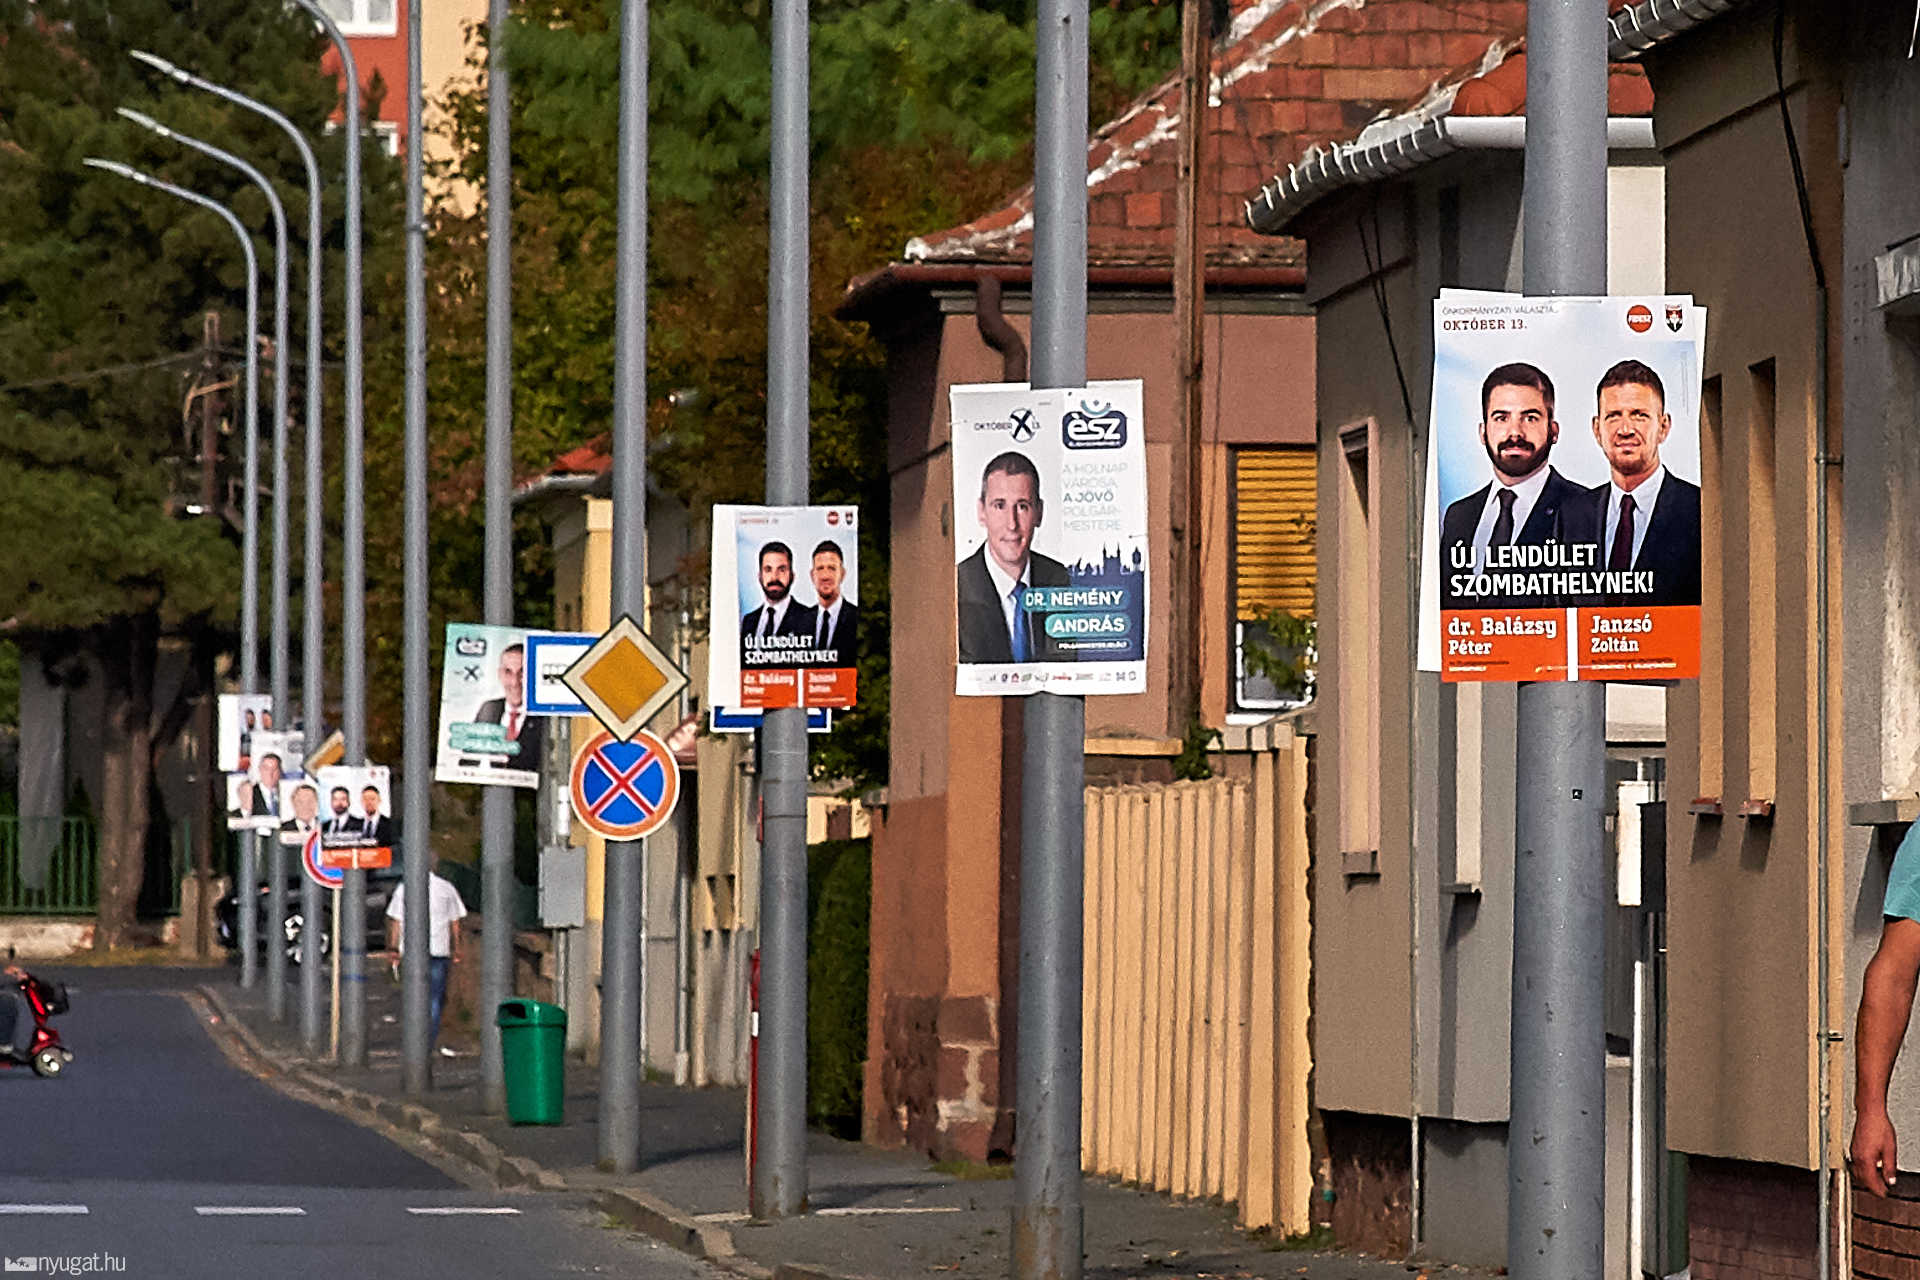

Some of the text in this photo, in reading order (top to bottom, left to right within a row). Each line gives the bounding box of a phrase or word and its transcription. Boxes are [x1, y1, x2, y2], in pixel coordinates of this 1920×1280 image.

[1443, 317, 1528, 331] OKTÓBER 13.
[1450, 538, 1598, 569] ÚJ LENDÜLET
[1450, 571, 1655, 597] SZOMBATHELYNEK!
[1050, 588, 1124, 606] NEMÉNY
[1051, 614, 1126, 633] ANDRÁS
[1448, 615, 1558, 639] dr. Balázsy
[1591, 613, 1653, 634] Janzsó
[1447, 638, 1493, 656] Péter
[1590, 636, 1640, 653] Zoltán
